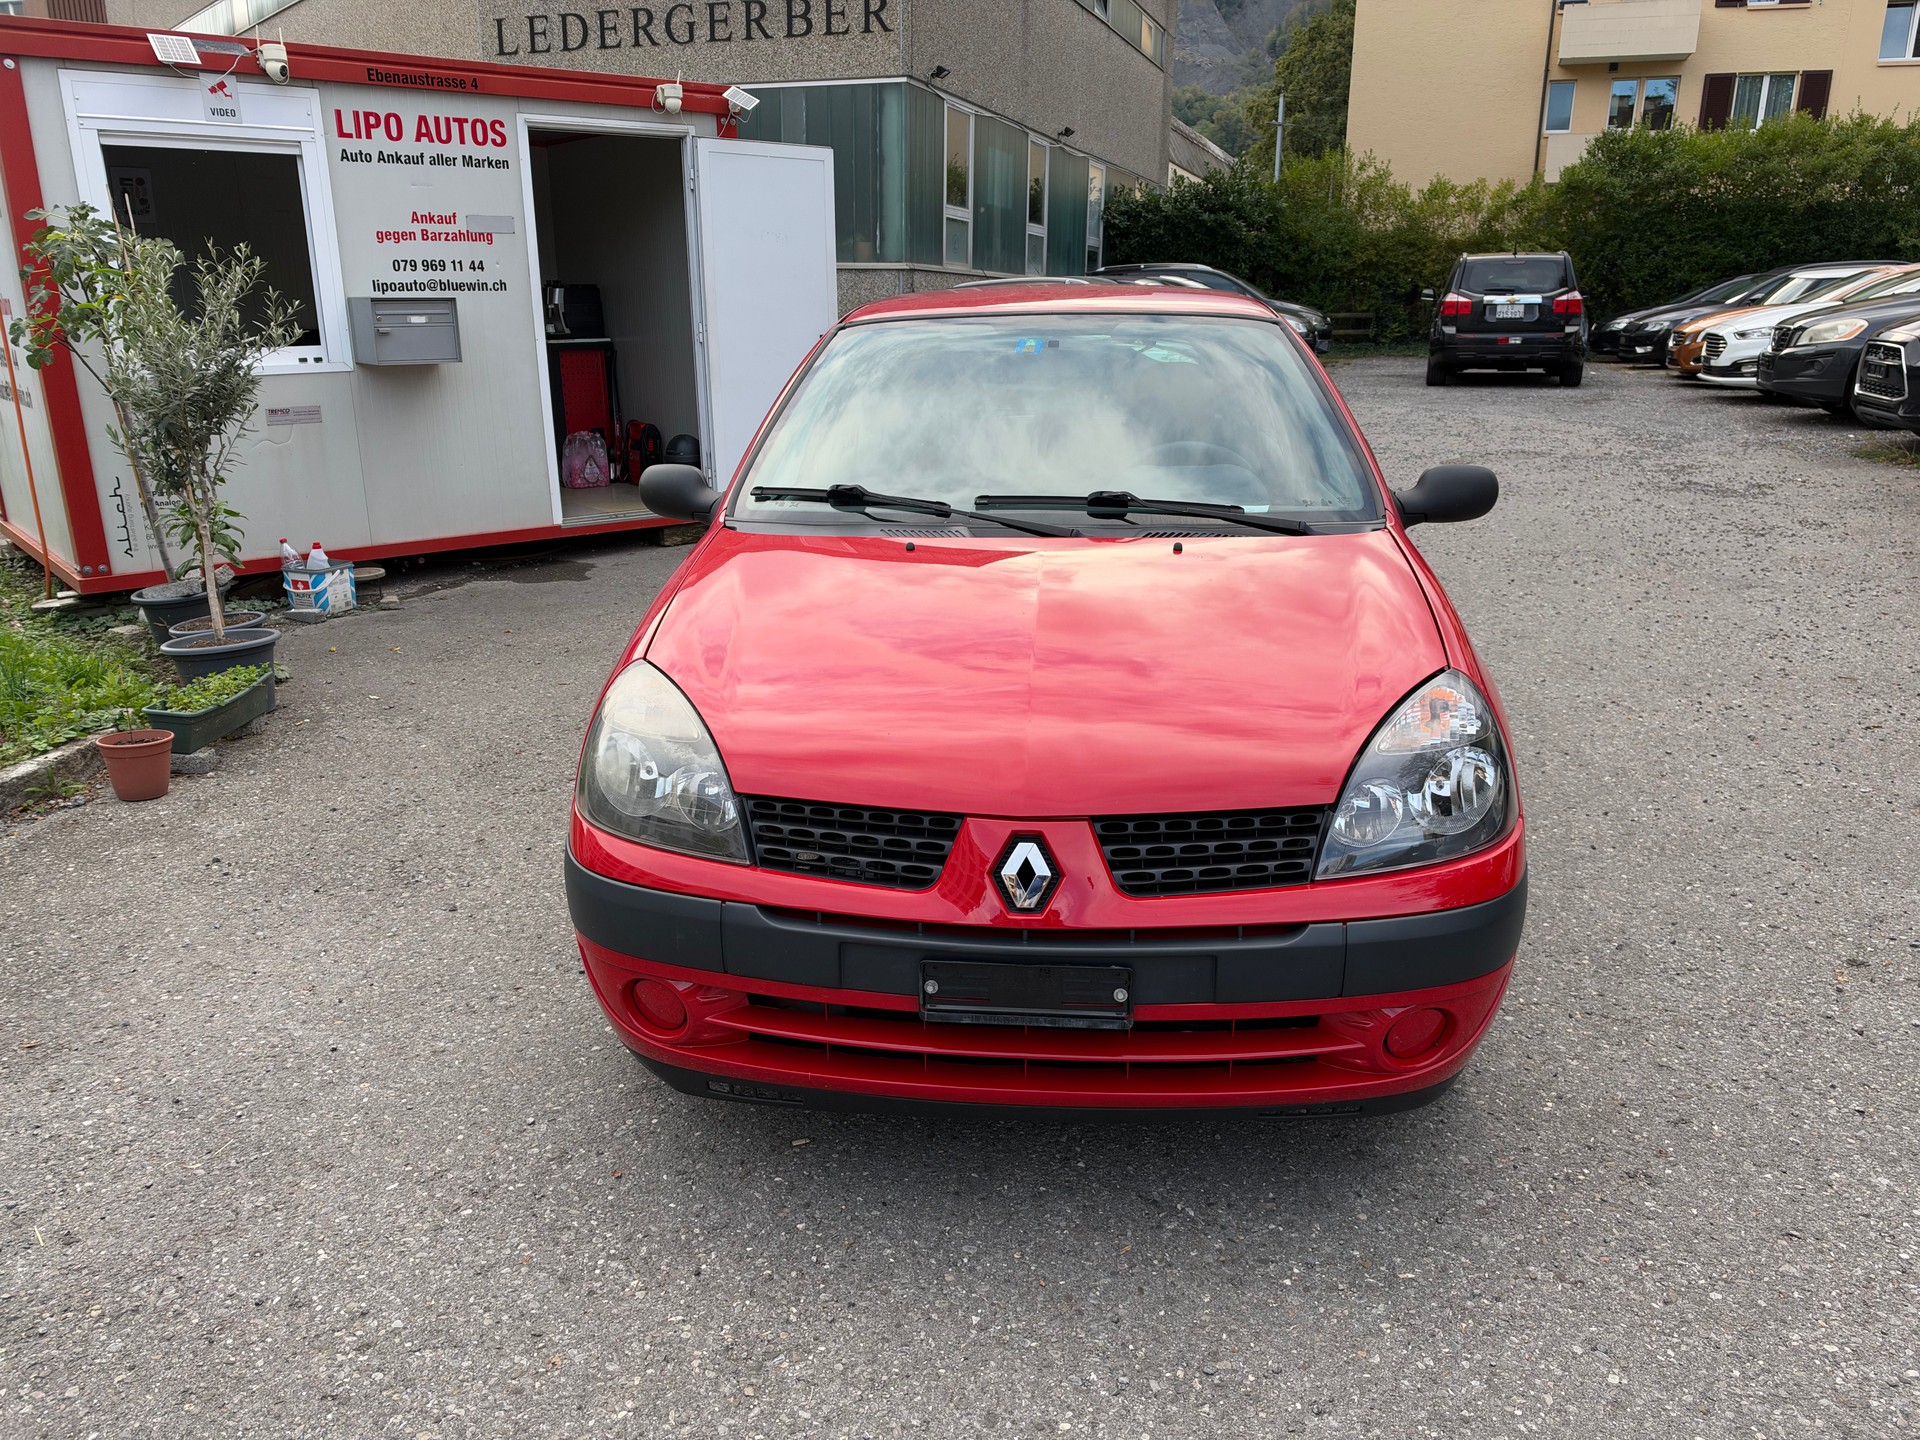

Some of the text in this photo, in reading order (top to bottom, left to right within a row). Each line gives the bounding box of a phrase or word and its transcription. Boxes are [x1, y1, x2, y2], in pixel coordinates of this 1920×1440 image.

[494, 0, 893, 56] LEDERGERBER
[366, 67, 479, 90] Ebenaustrasse 4
[210, 107, 236, 118] VIDEO
[334, 108, 507, 148] LIPO AUTOS
[340, 148, 510, 170] Auto Ankauf aller Marken
[411, 210, 457, 225] Ankauf
[376, 228, 494, 245] gegen Barzahlung
[392, 259, 485, 272] 079 969 11 44
[372, 279, 507, 295] lipoauto@bluewin.ch
